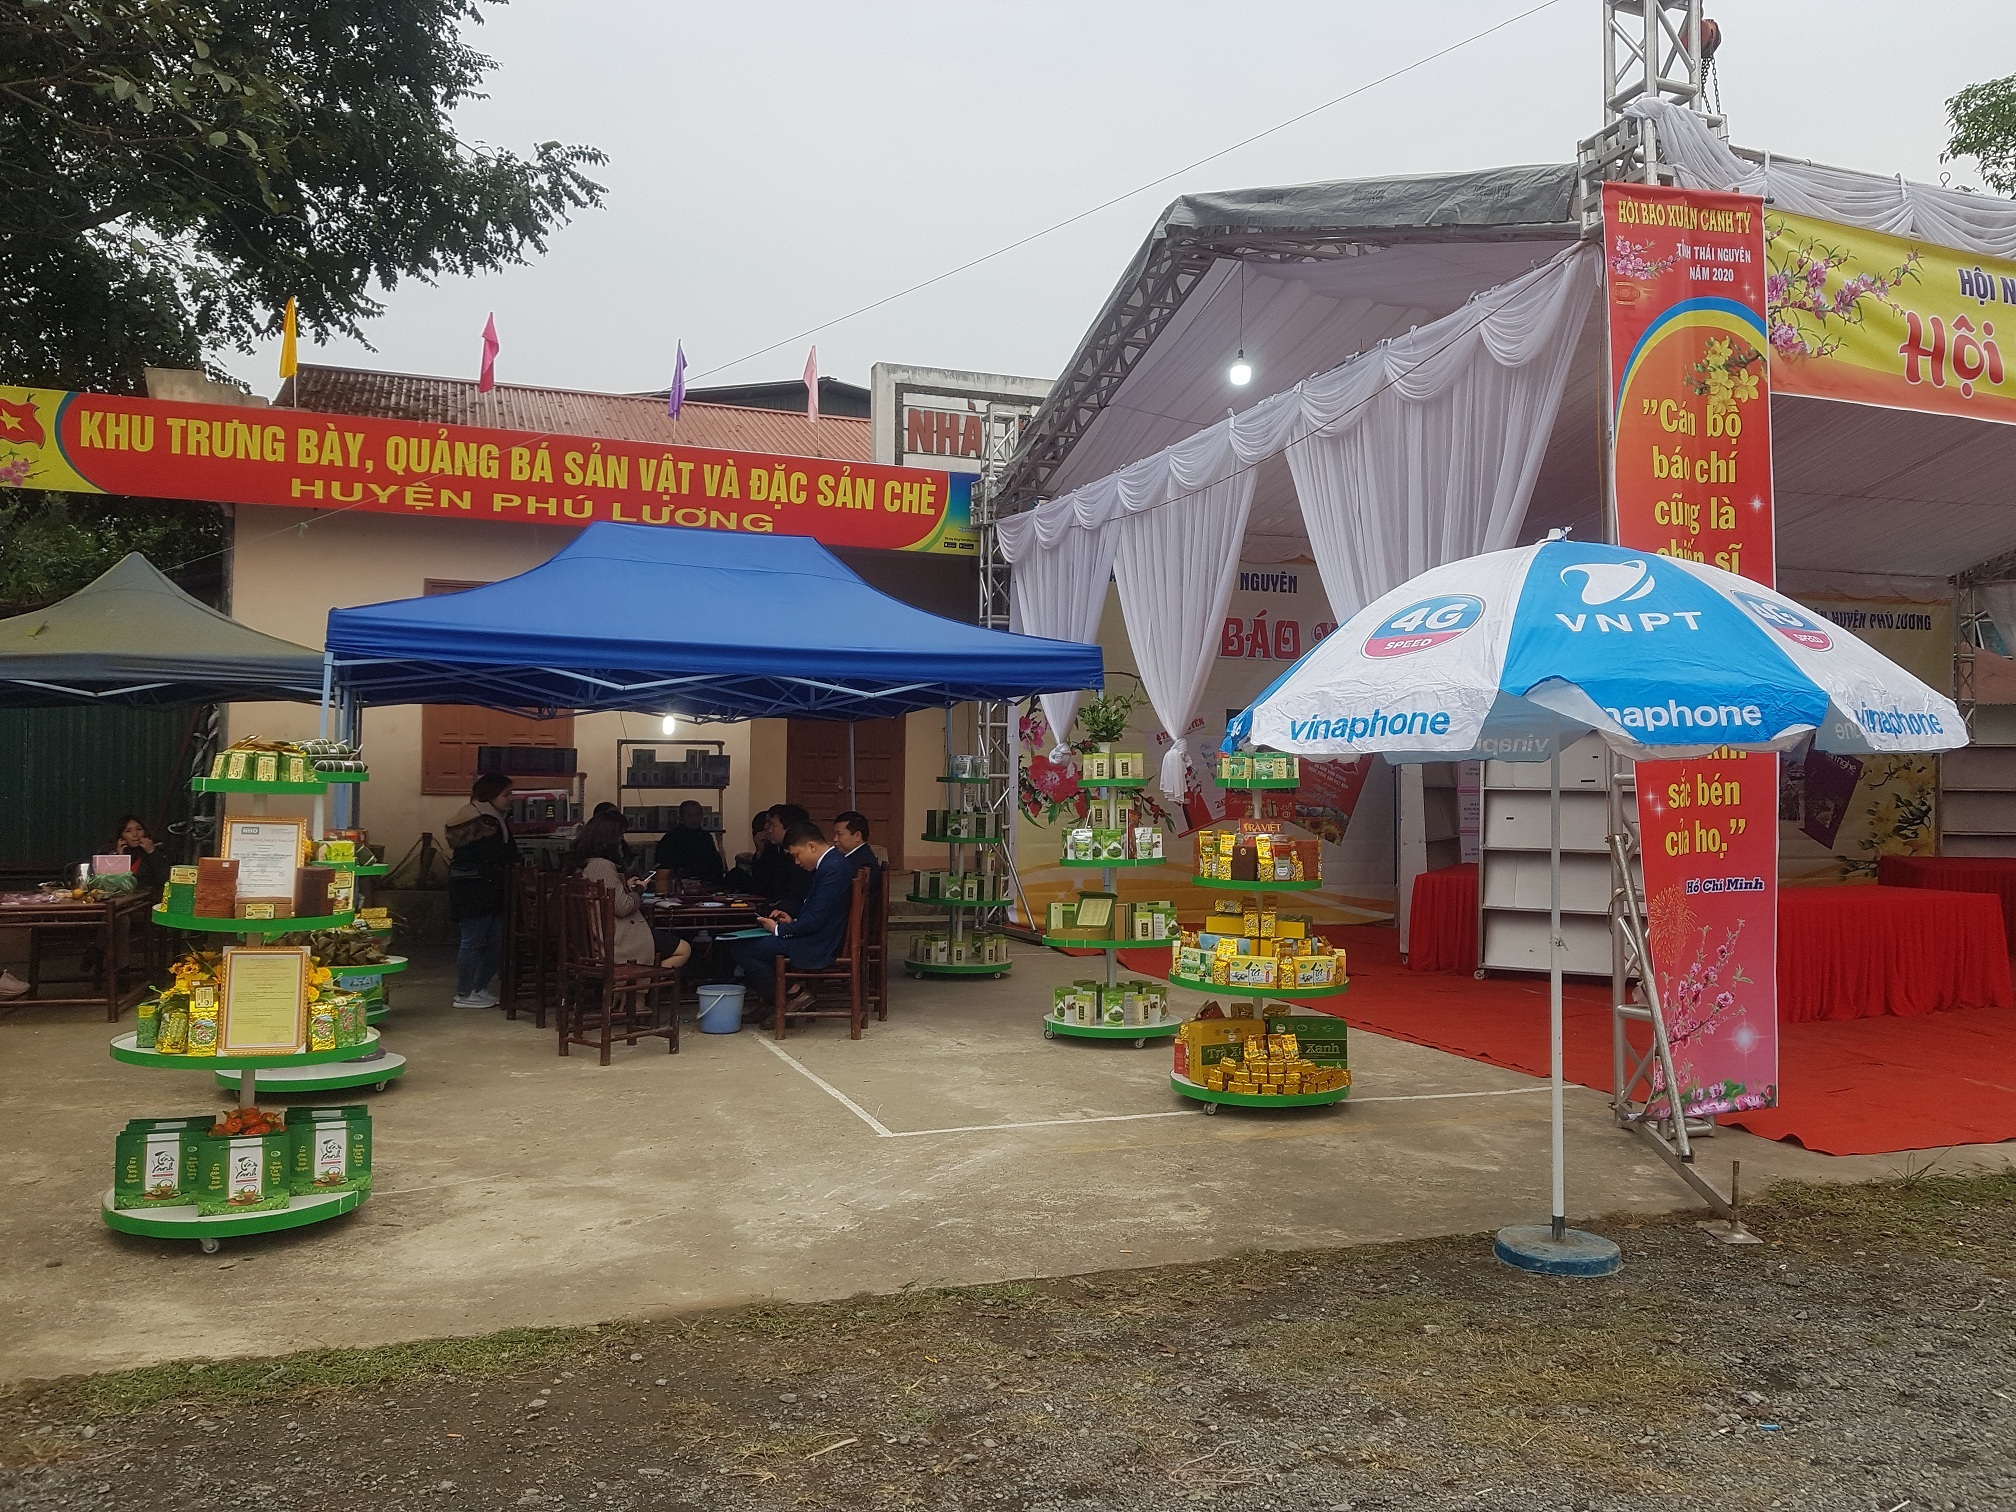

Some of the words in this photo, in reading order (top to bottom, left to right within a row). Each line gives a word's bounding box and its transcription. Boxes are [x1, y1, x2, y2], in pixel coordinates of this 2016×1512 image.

[1618, 196, 1640, 229] HỘI
[1641, 198, 1665, 226] BÁO
[1700, 209, 1735, 232] CANH
[1736, 206, 1751, 233] TÝ
[1693, 244, 1714, 261] THÁI
[1717, 246, 1751, 263] NGUYÊN
[1689, 264, 1710, 280] NĂM
[1712, 267, 1734, 281] 2020
[1958, 266, 1996, 305] HỘI
[1898, 310, 2004, 399] Hội
[908, 399, 982, 457] NHÀ
[80, 410, 154, 452] KHU
[166, 417, 286, 462] TRƯNG
[297, 423, 375, 474] BÀY,
[386, 428, 500, 479] QUẢNG
[510, 442, 554, 484] BÁ
[564, 442, 629, 489] SẢN
[638, 453, 694, 501] VẬT
[703, 458, 741, 499] VÀ
[749, 463, 808, 509] ĐẶC
[817, 465, 875, 510] SẢN
[884, 476, 936, 516] CHÈ
[1652, 445, 1690, 480] báo
[1694, 451, 1738, 483] chí
[290, 477, 472, 511] HUYỆN
[493, 493, 593, 519] PHÚ
[612, 502, 774, 532] LƯƠNG
[1654, 492, 1701, 535] cũng
[1710, 496, 1736, 529] là
[1240, 571, 1298, 594] NGUYÊN
[1220, 609, 1301, 660] BÁO
[1390, 603, 1469, 632] 4G
[1555, 611, 1702, 633] VNPT
[1870, 611, 1893, 628] PHÚ
[1895, 613, 1931, 631] LƯƠNG
[1384, 638, 1432, 650] SPEED
[1290, 709, 1451, 742] vinaphone
[1602, 699, 1763, 732] naphone
[1854, 700, 1944, 740] vinaphone
[1668, 768, 1691, 809] sắc
[1697, 773, 1741, 807] bén
[1665, 817, 1690, 857] của
[1686, 877, 1699, 895] Hồ
[1702, 880, 1723, 893] Chí
[1725, 876, 1765, 892] Minh
[1305, 1042, 1341, 1054] Xanh
